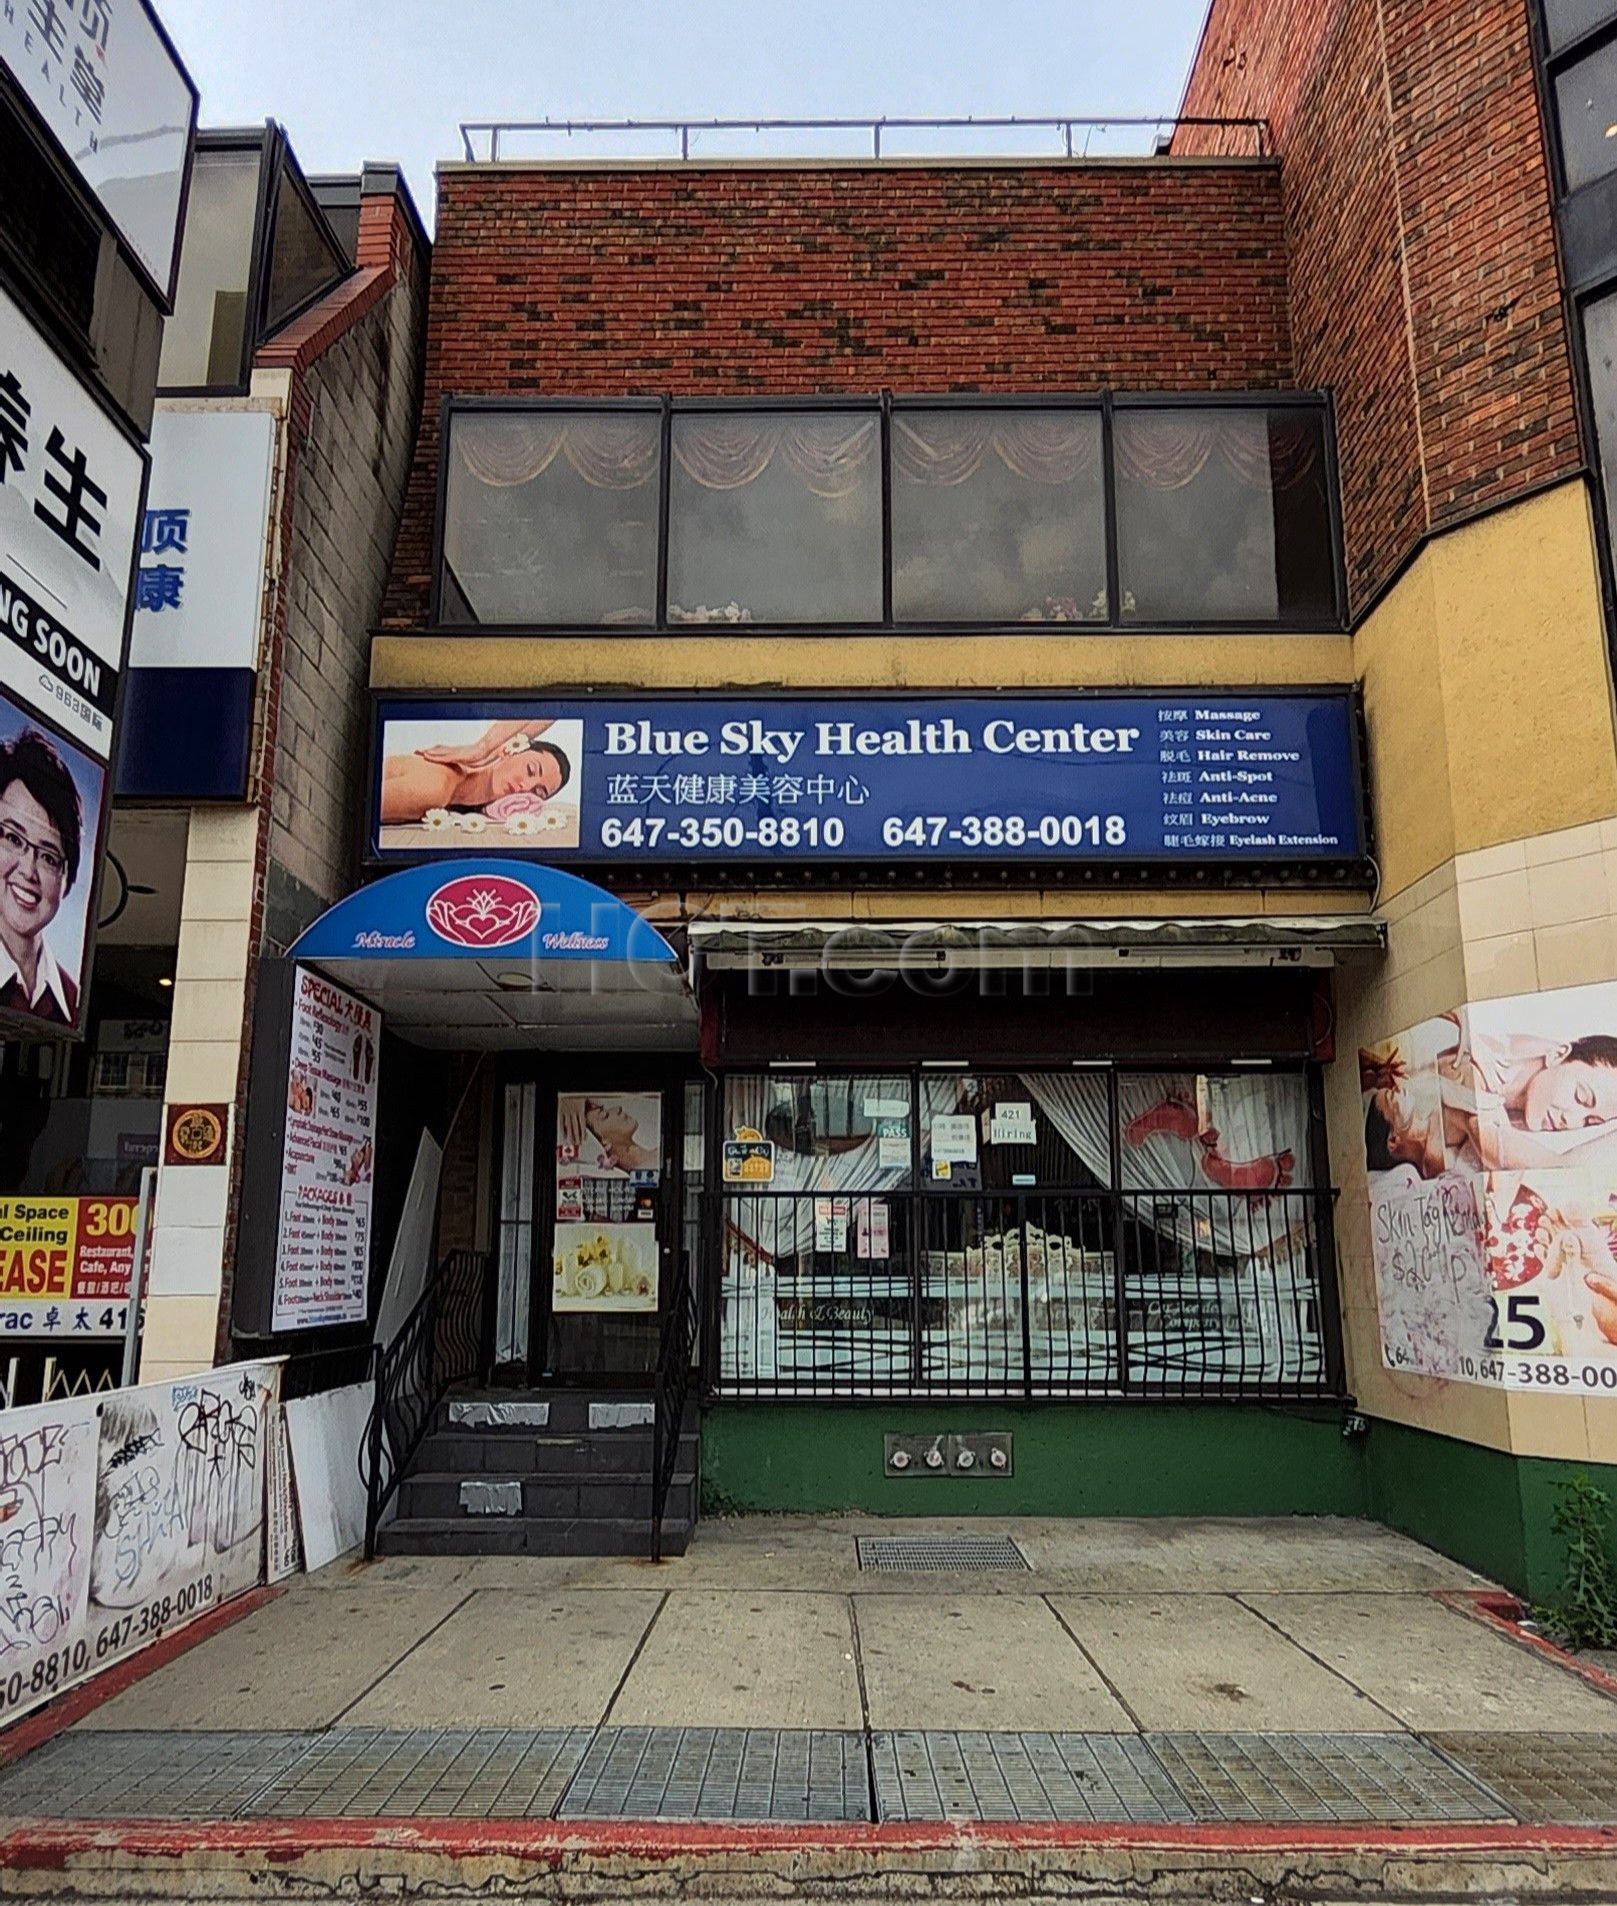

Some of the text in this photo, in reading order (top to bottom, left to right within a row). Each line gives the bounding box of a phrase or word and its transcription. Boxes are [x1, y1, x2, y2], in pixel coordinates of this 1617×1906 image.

[33, 618, 101, 697] SOON
[1194, 709, 1261, 722] Massage
[604, 719, 1140, 764] Blue Sky Health Center
[1160, 729, 1190, 742] 美容
[1195, 729, 1272, 741] Skin Care
[1197, 750, 1300, 762] Hair Remove
[1199, 770, 1274, 784] Anti-Spot
[606, 773, 870, 806] 蓝天健康美容中心
[1200, 791, 1278, 803] Anti-Acne
[1201, 813, 1270, 827] Eyebrow
[601, 815, 1127, 848] 647-350-8810 647-388-0018
[1229, 834, 1339, 847] Eyelash Extension
[351, 930, 610, 950] Miracle Wellness
[300, 974, 344, 1015] SPECIAL
[1001, 1109, 1021, 1119] 421
[882, 1127, 908, 1138] PASS
[993, 1127, 1032, 1139] Hiring
[297, 1183, 337, 1204] PACKAGES
[14, 1204, 69, 1222] Space
[1377, 1200, 1415, 1243] Skin
[0, 1226, 68, 1245] Ceiling
[80, 1246, 134, 1258] Restaurant,
[80, 1261, 131, 1275] Cafe, Any
[43, 1306, 92, 1332] 卓 太
[96, 1573, 213, 1658] 647-388-0018
